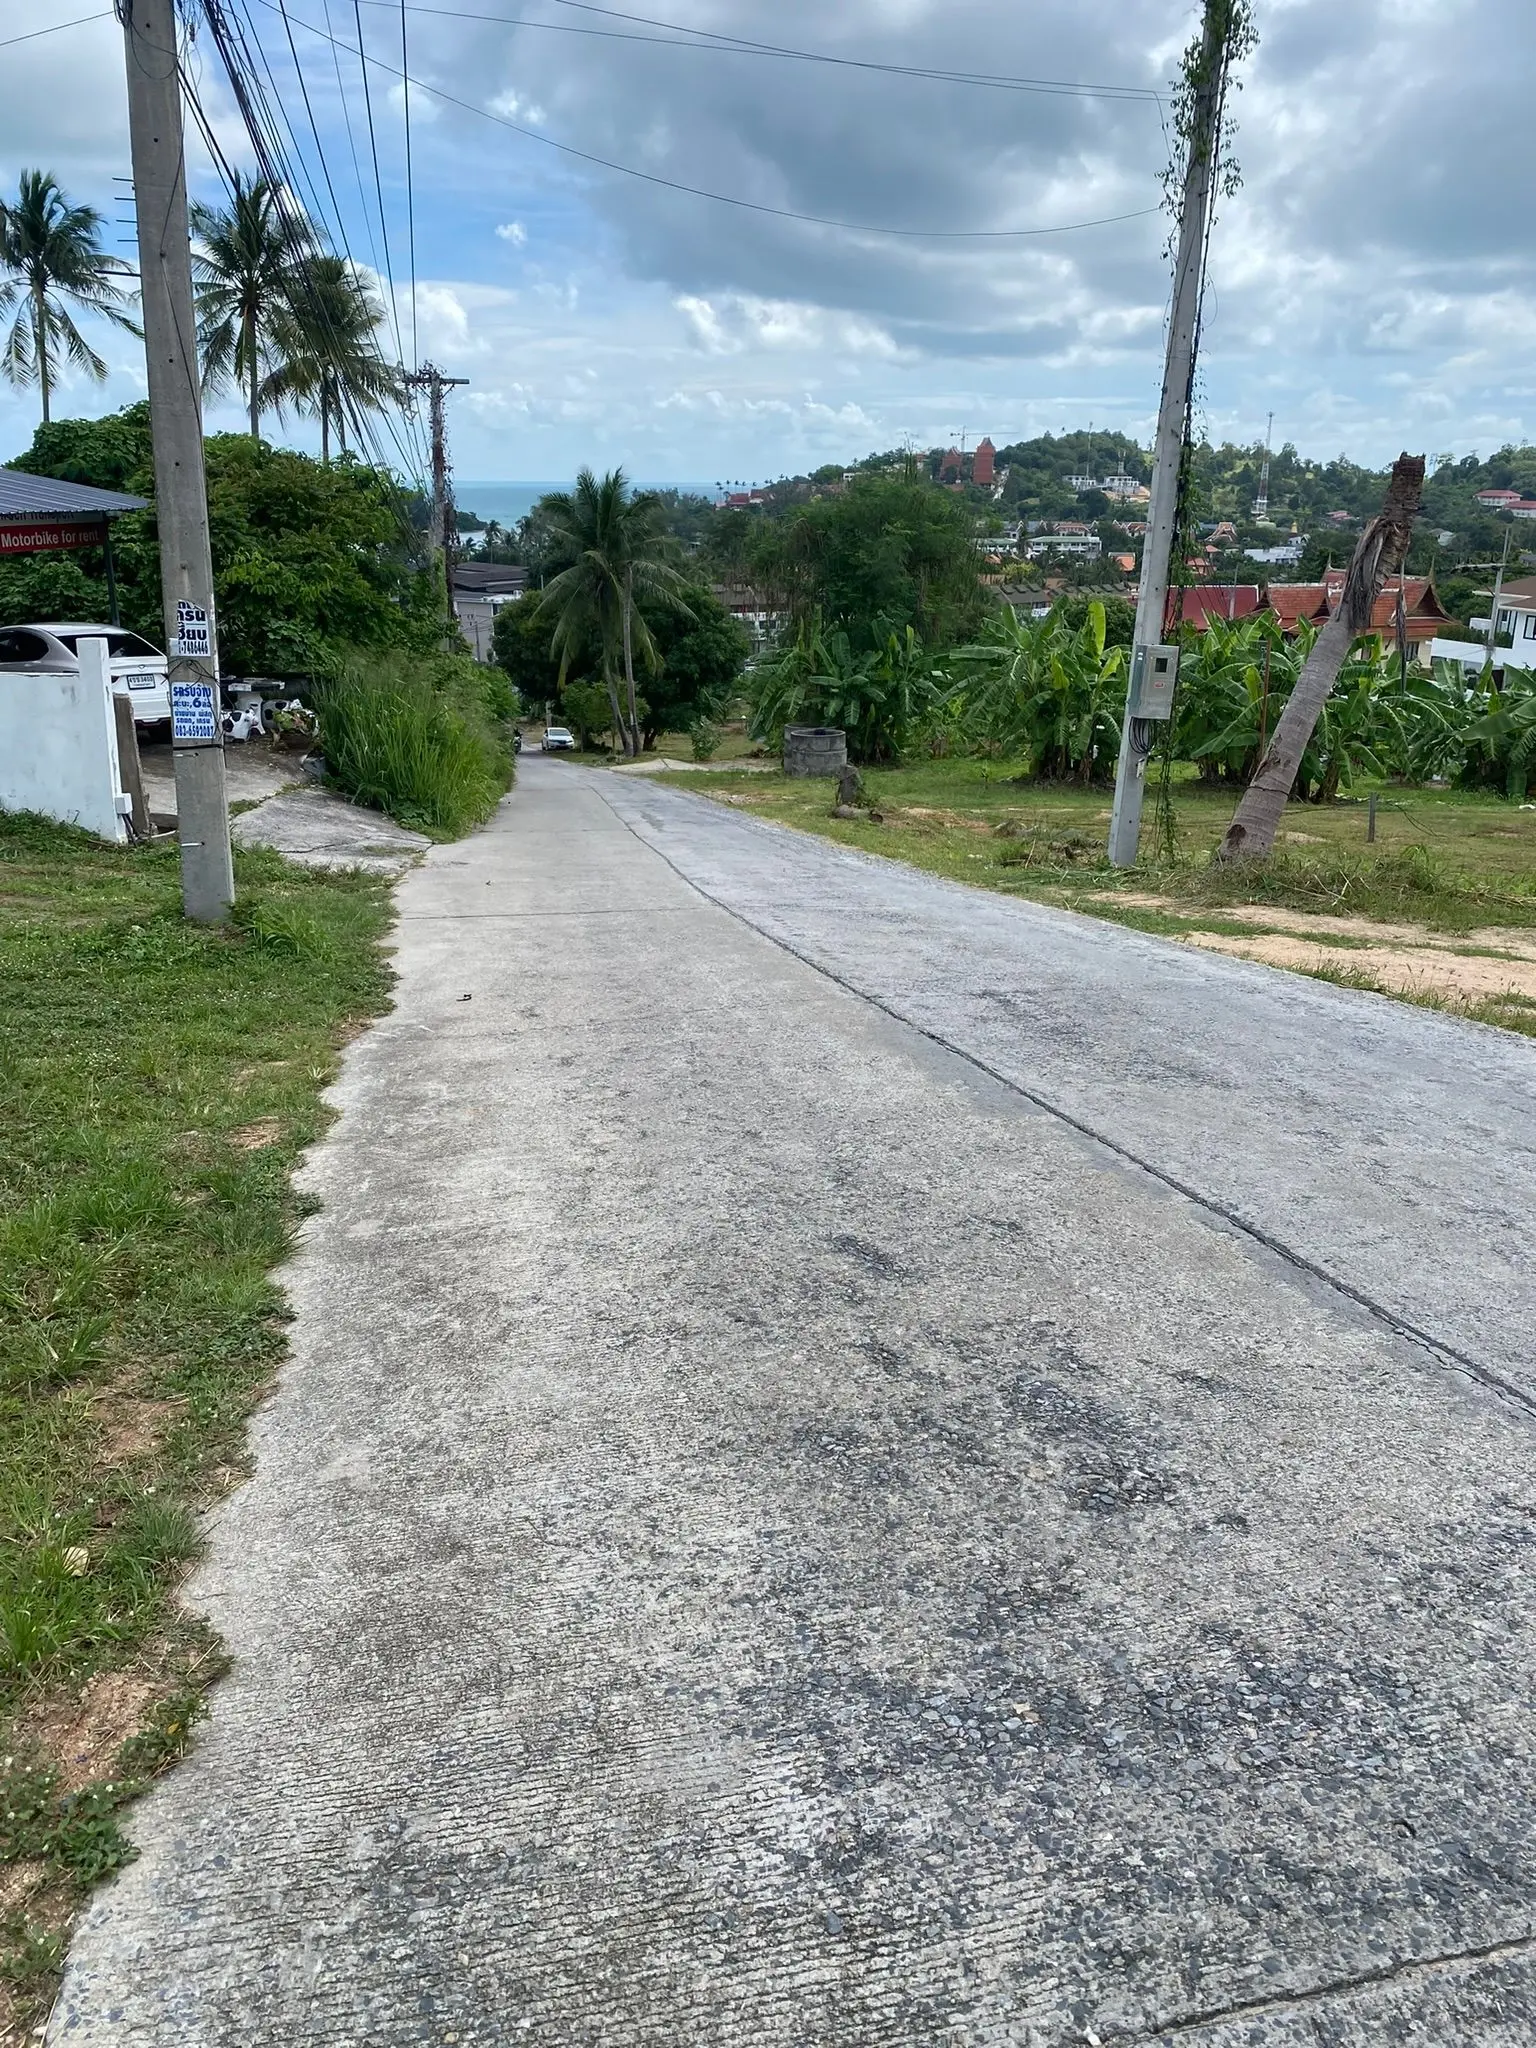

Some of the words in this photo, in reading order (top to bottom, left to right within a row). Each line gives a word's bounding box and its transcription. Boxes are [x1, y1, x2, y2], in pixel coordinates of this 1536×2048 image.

[1, 531, 59, 548] Motorbike
[61, 530, 76, 543] for
[79, 530, 99, 542] rent
